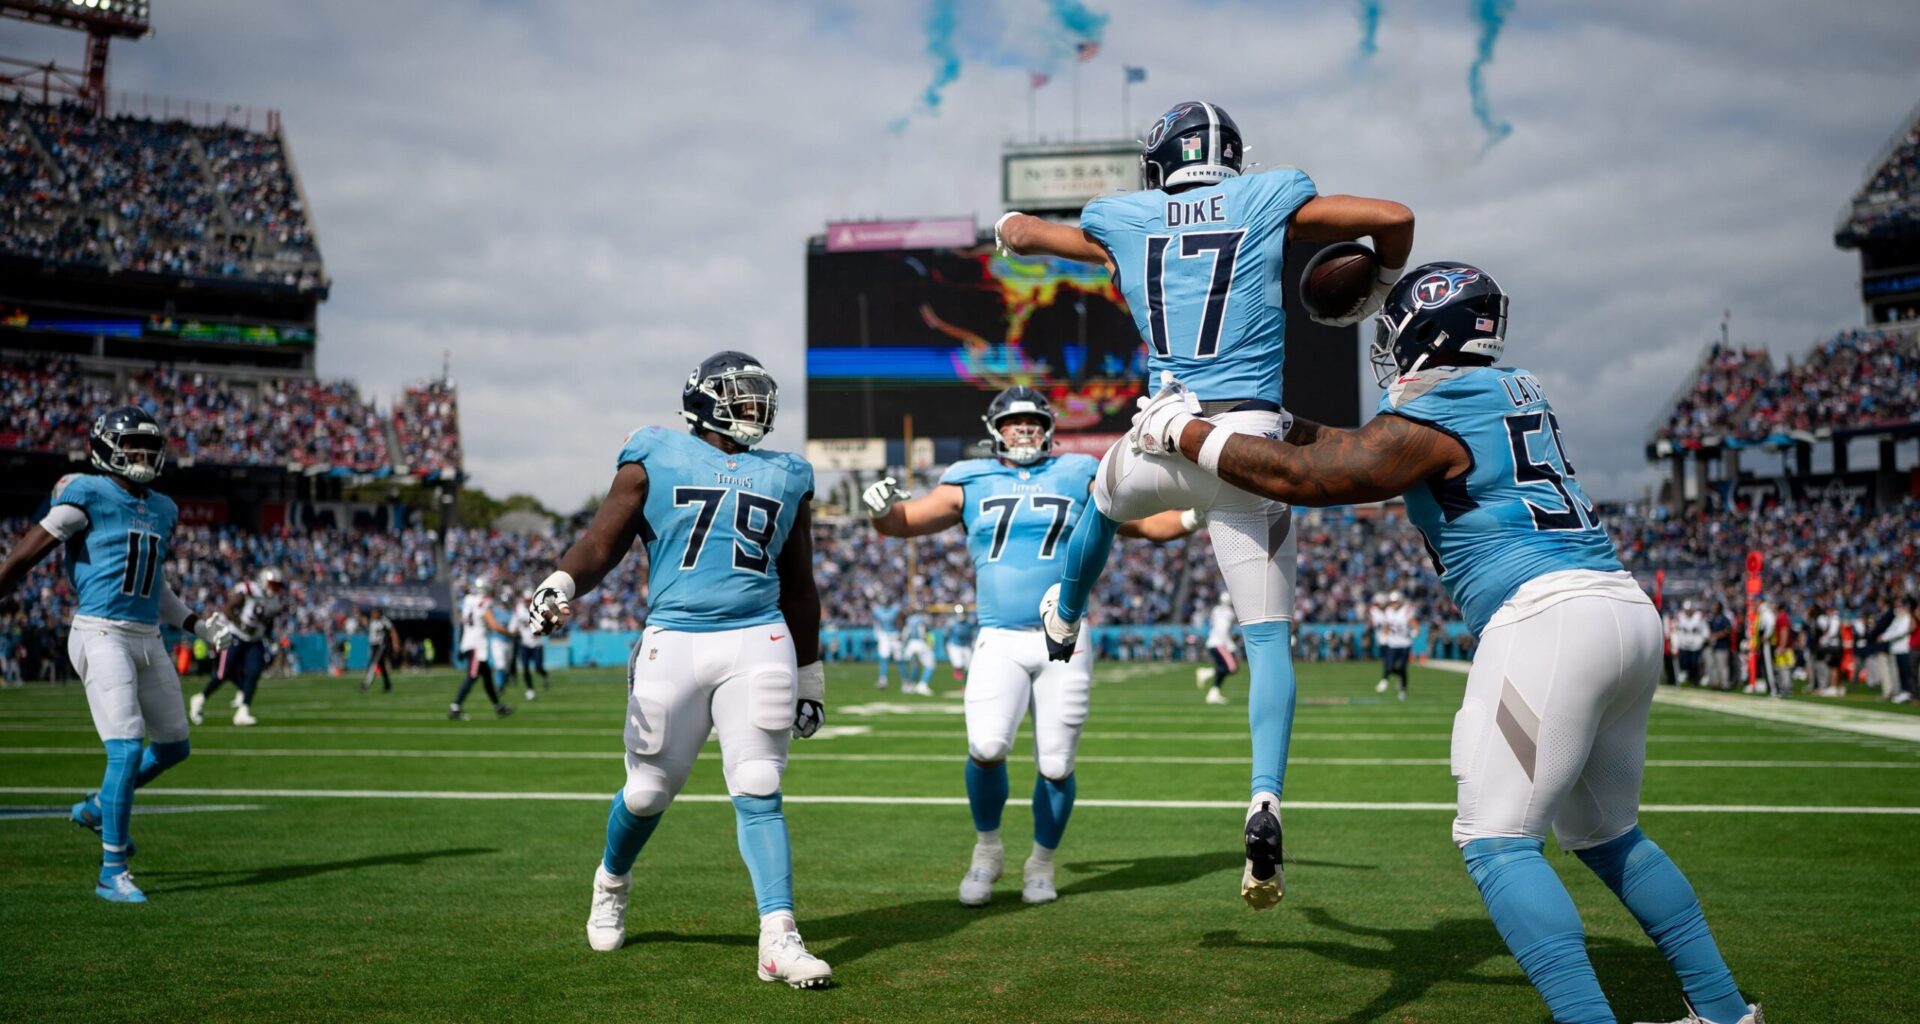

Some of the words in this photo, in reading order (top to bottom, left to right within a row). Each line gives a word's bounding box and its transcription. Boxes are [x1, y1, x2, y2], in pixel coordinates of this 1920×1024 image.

[1165, 194, 1226, 228] DIKE
[1144, 228, 1248, 359] 17
[1421, 281, 1447, 301] T
[1500, 374, 1546, 408] LAT
[673, 486, 784, 579] 79
[979, 494, 1075, 562] 77
[121, 528, 161, 597] 11
